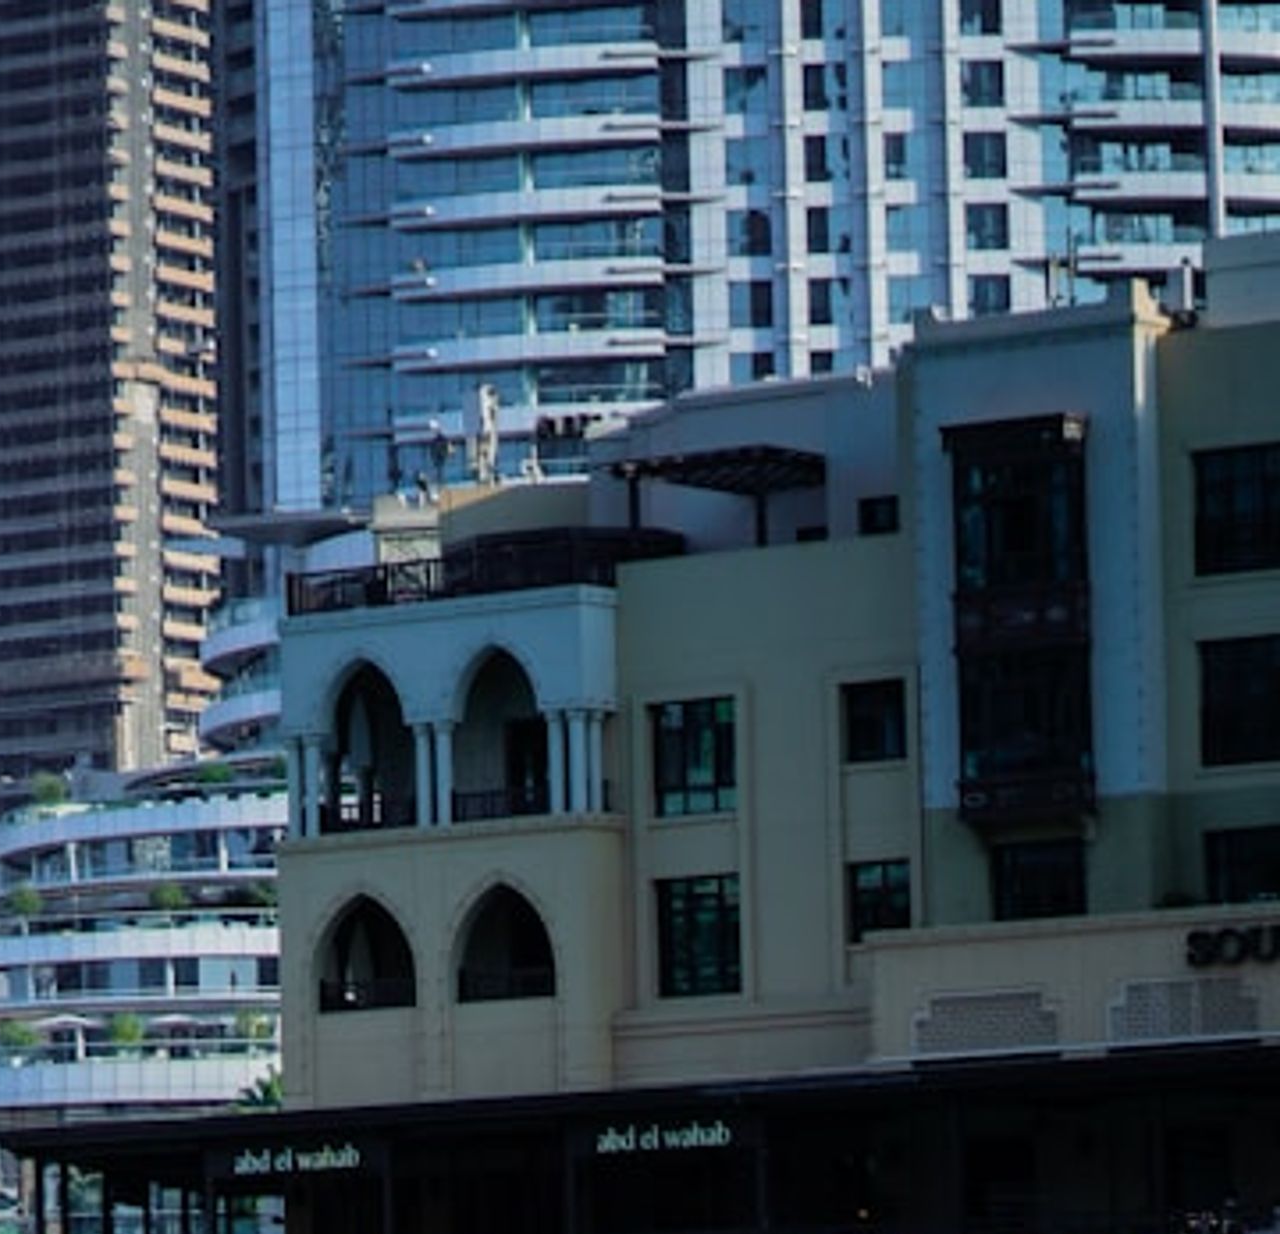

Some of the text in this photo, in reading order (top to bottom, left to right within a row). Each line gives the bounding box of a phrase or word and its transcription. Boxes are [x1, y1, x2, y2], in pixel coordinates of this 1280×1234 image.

[596, 1120, 731, 1154] abd el wahab
[233, 1142, 360, 1174] abd el wahab
